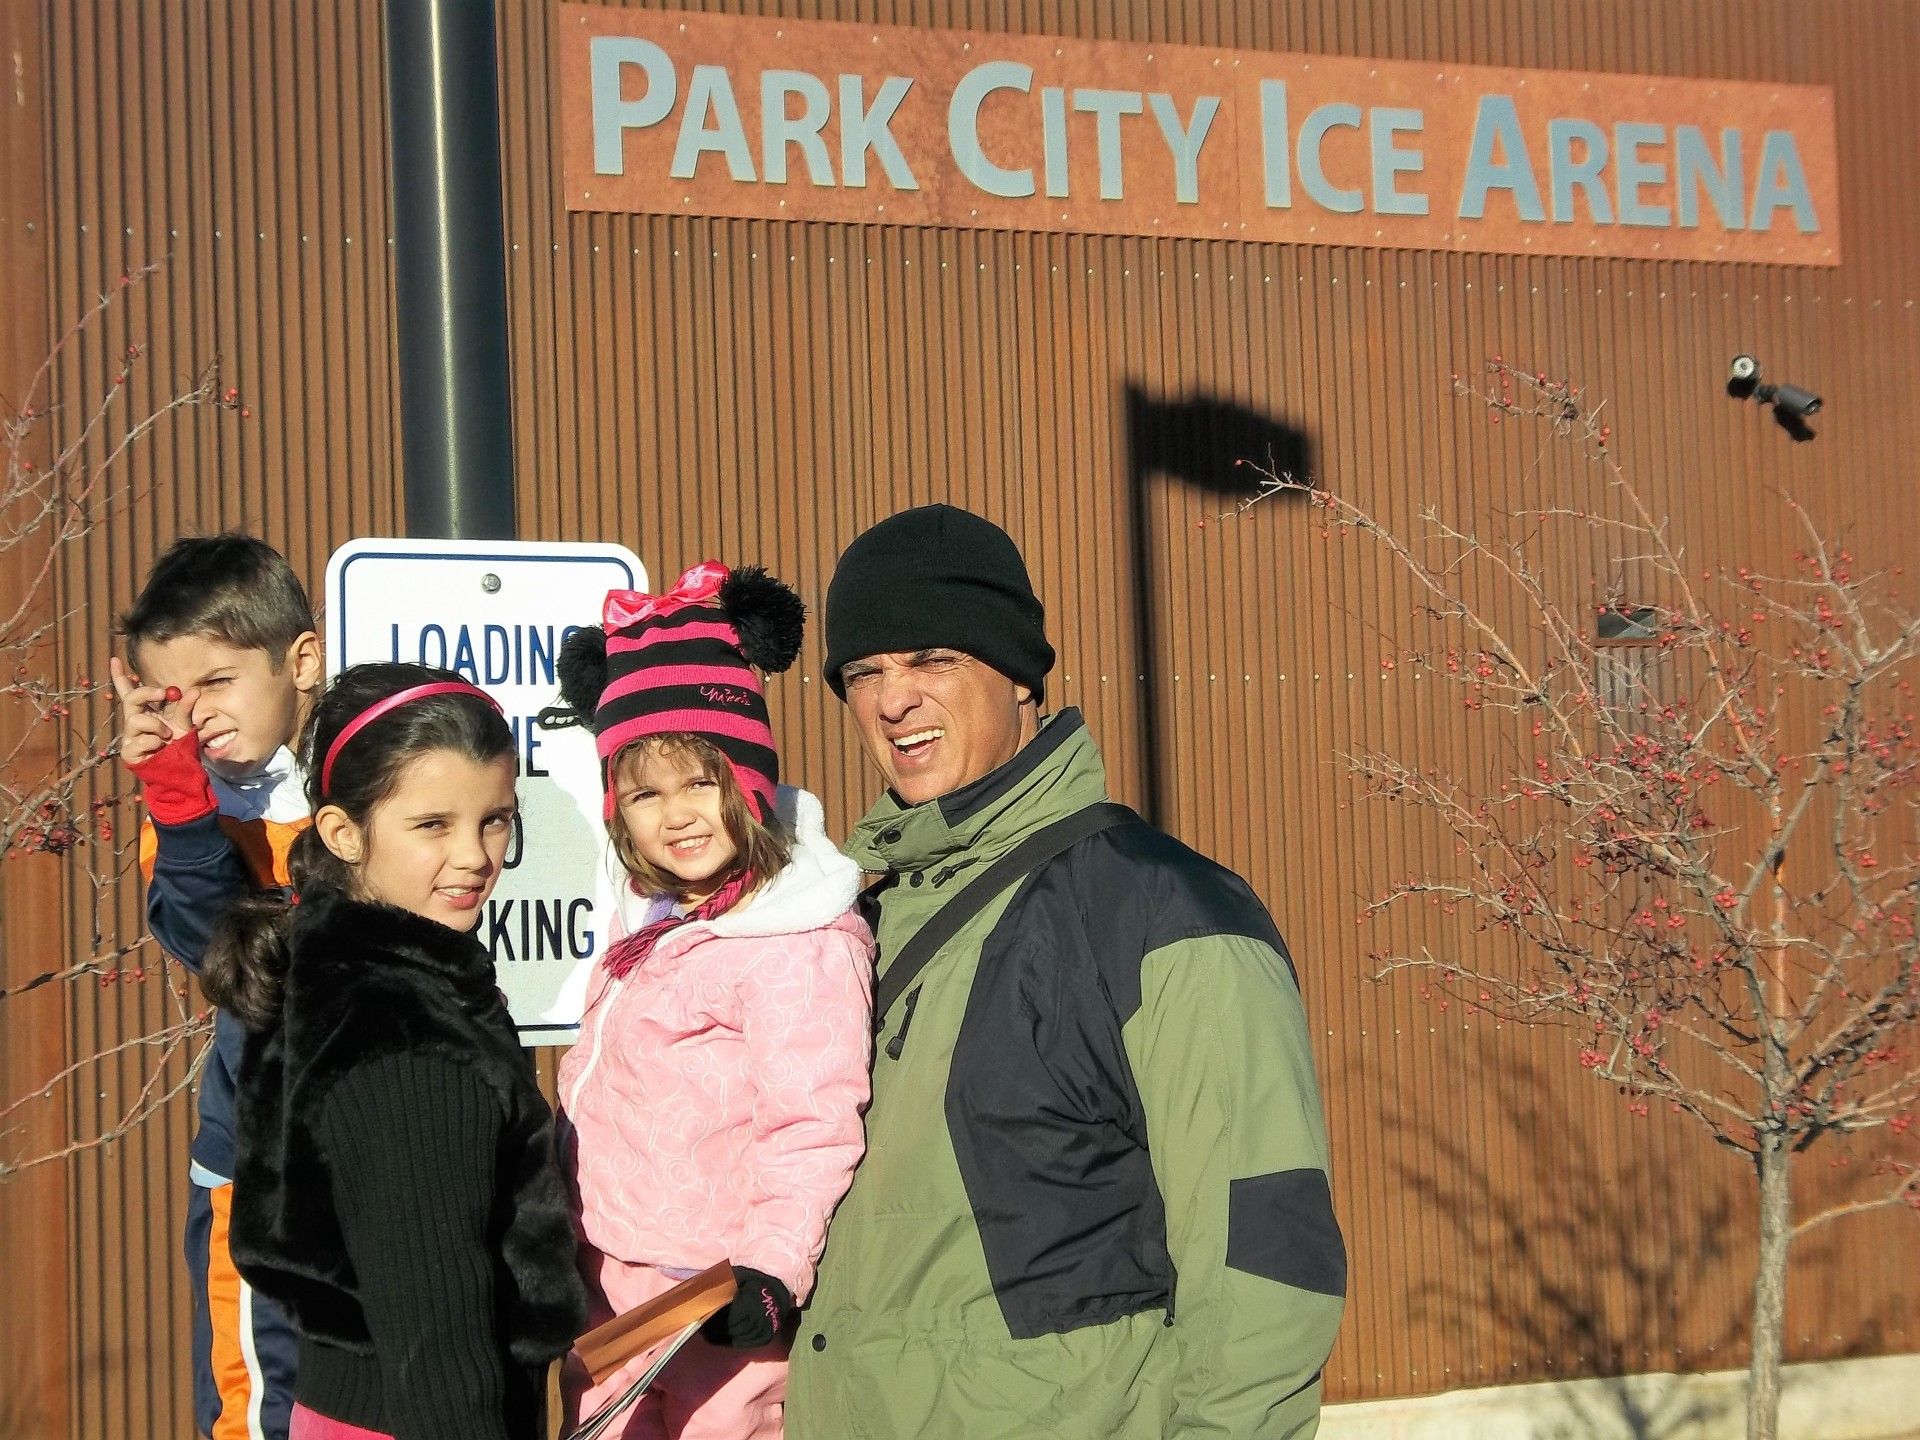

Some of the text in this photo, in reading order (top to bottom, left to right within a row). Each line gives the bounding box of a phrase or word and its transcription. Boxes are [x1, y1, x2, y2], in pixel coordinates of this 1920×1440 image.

[590, 36, 1821, 234] PARK CITY ICE ARENA
[476, 898, 595, 962] KING
